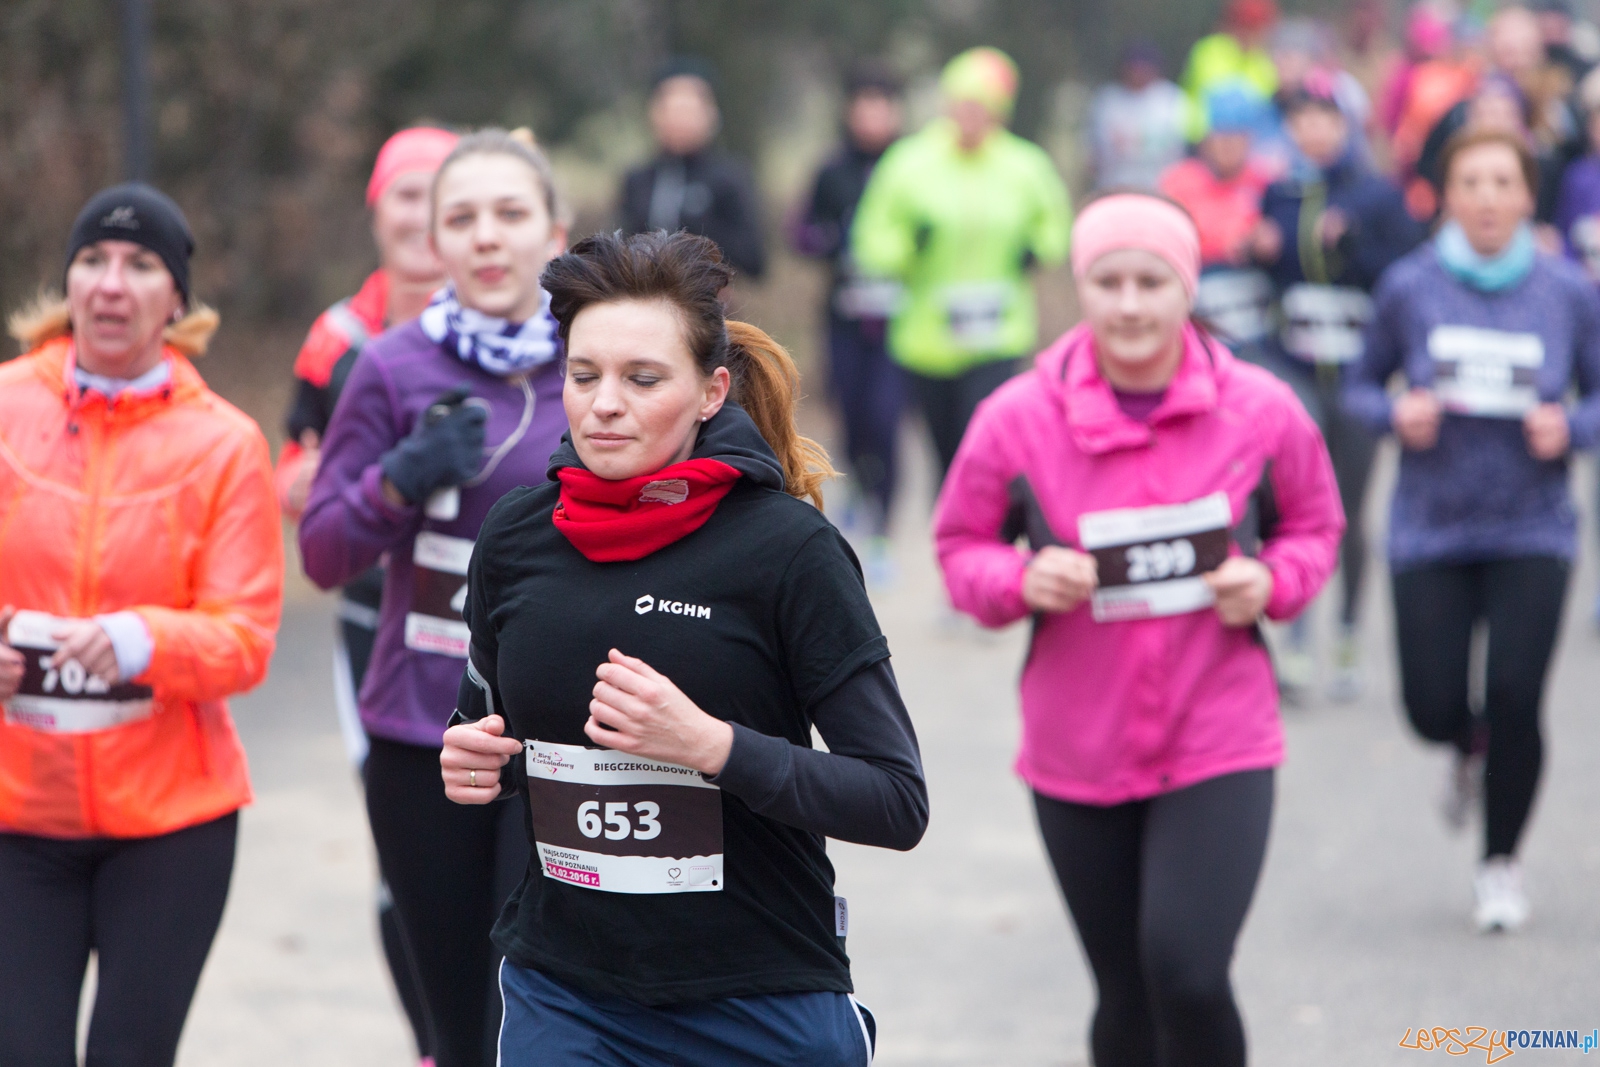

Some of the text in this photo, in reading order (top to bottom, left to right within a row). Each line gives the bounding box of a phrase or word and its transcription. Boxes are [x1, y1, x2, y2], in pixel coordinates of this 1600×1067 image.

[1126, 538, 1196, 583] 299
[658, 600, 711, 620] KGHM
[577, 800, 662, 841] 653
[543, 848, 580, 861] NAJSŁODSZY
[565, 861, 598, 873] POZNANIU
[591, 876, 599, 885] r.
